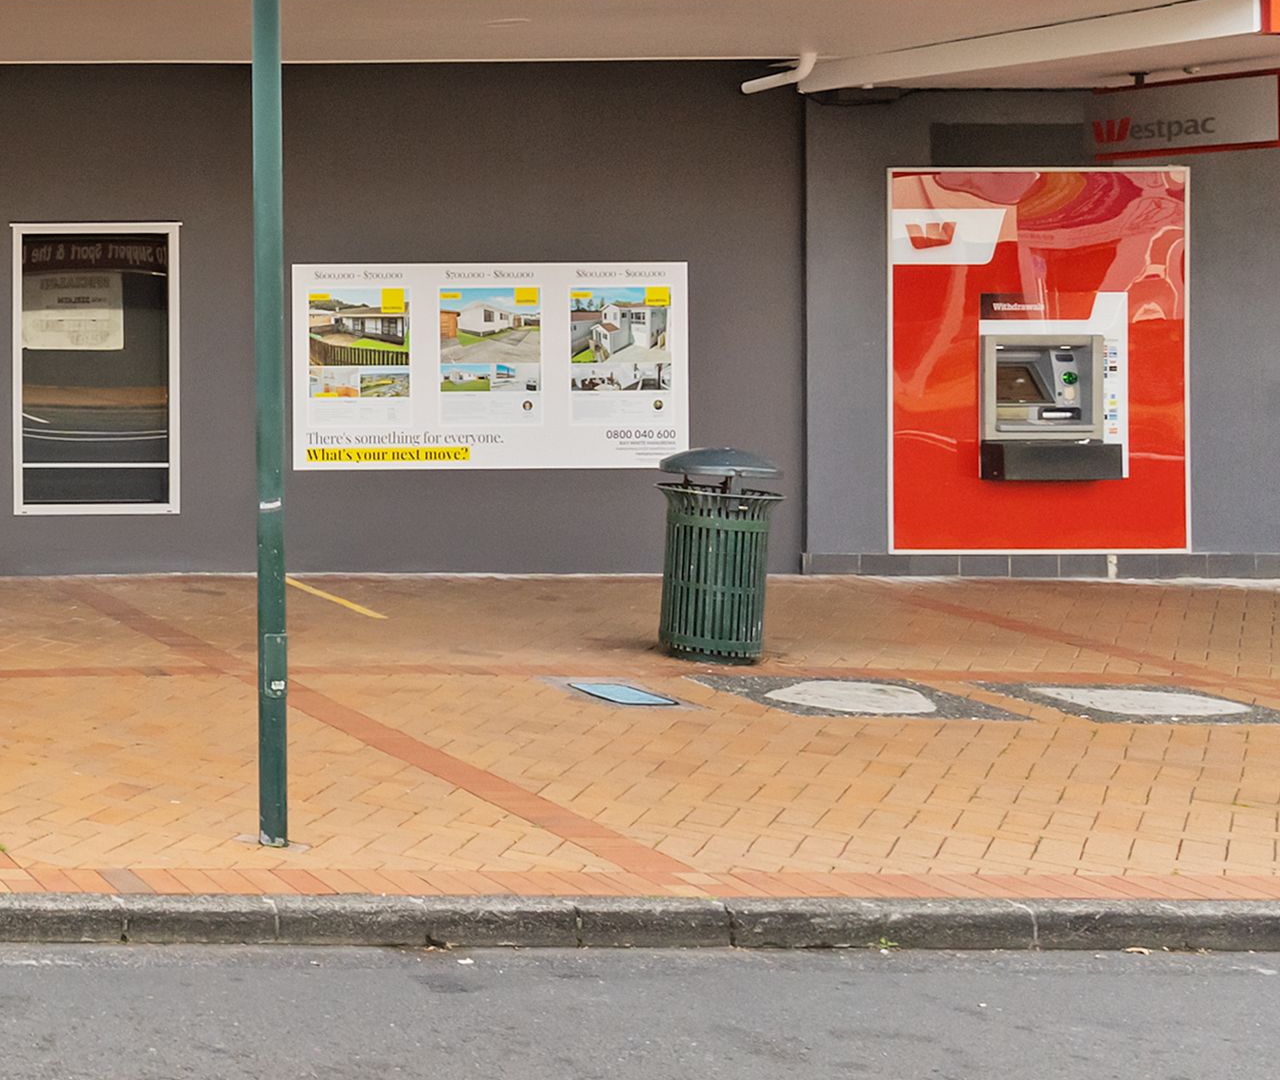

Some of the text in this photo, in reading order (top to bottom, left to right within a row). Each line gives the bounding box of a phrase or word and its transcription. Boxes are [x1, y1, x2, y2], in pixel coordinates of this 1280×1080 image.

[1092, 114, 1217, 144] Westpac
[306, 431, 504, 446] There's something for everyone.
[606, 429, 676, 439] 0800 040 600
[306, 447, 469, 463] What's your next move?
